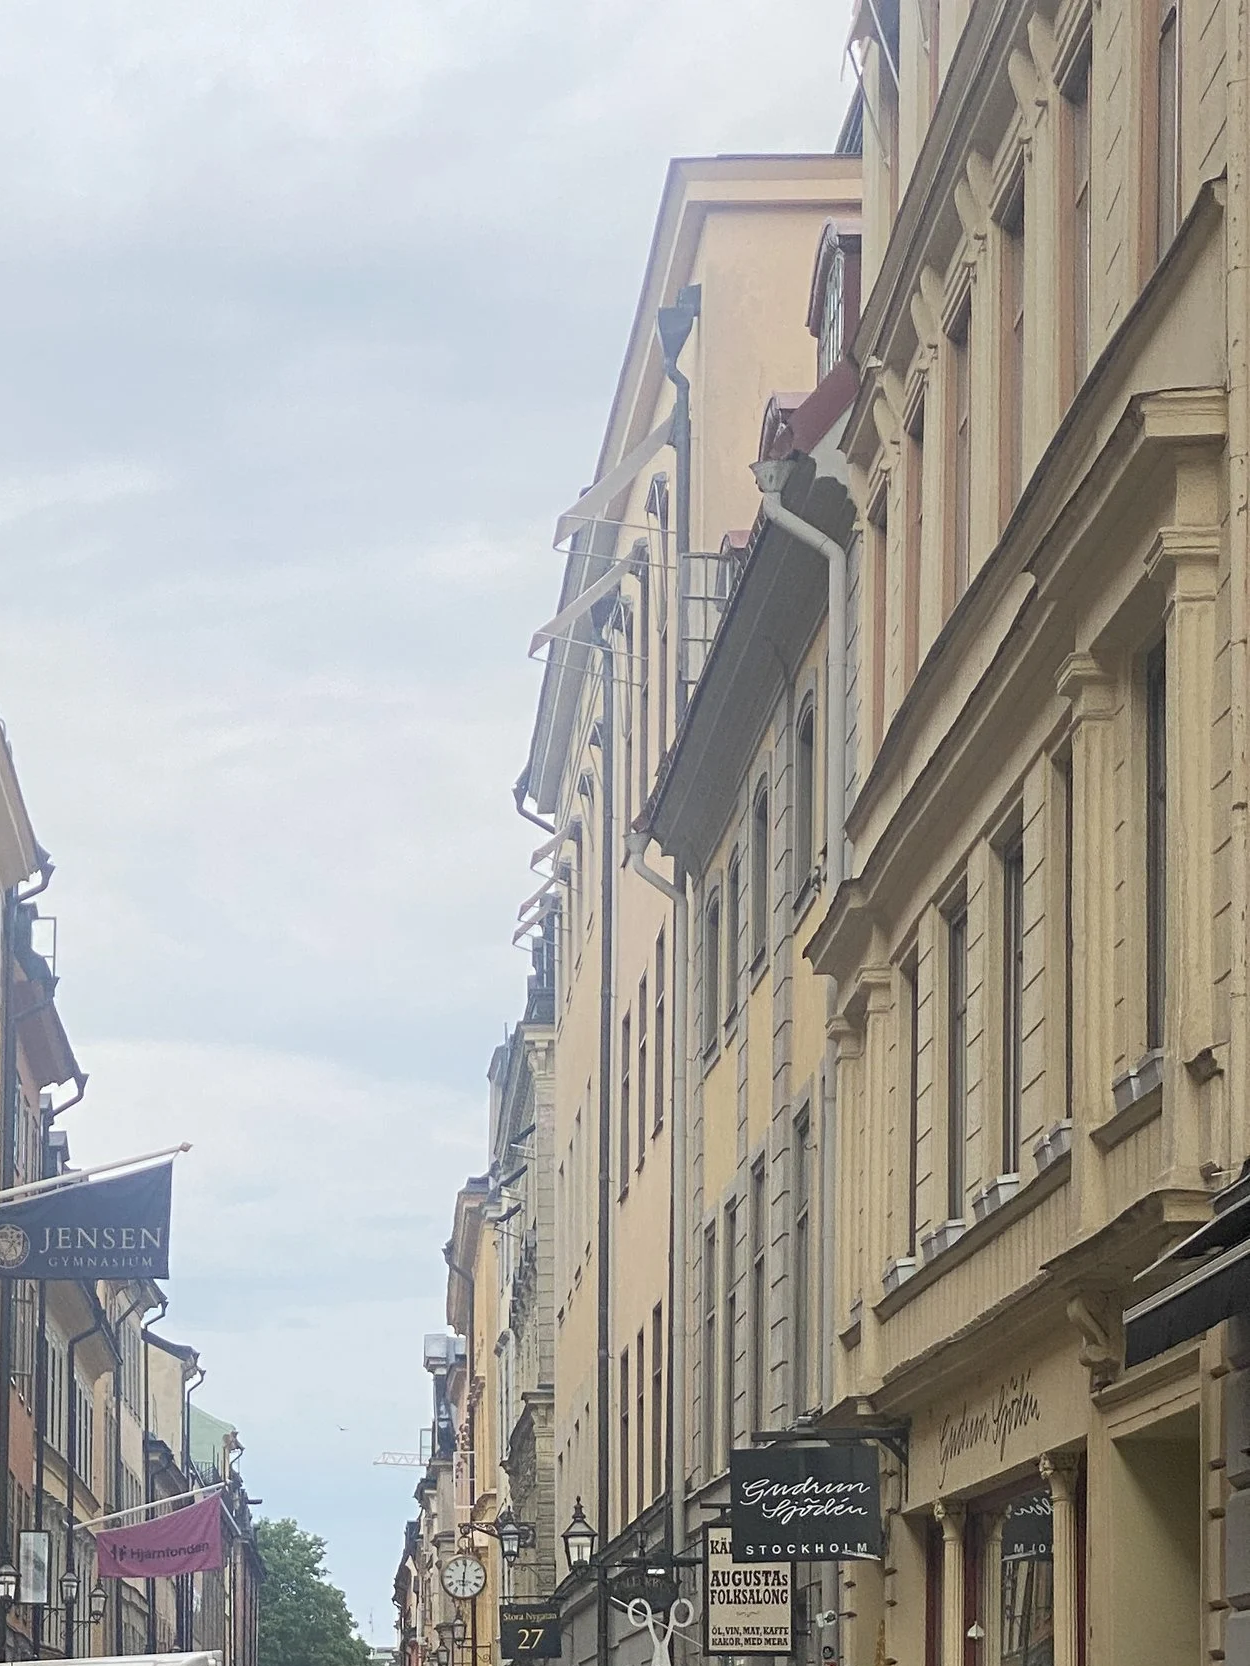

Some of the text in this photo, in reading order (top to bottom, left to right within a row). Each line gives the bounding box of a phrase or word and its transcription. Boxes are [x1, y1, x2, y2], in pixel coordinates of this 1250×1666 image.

[39, 1227, 162, 1254] JENSEN
[47, 1256, 154, 1268] GYMNASIUM
[740, 1476, 871, 1506] Gudrun
[130, 1541, 210, 1563] Hjärnfonden
[745, 1542, 868, 1555] STOCKHOLM
[710, 1589, 788, 1605] FOLKSALONG
[503, 1612, 557, 1623] Stora Nygatan
[763, 1626, 789, 1635] KAFFE
[517, 1628, 545, 1650] 27
[744, 1637, 762, 1646] MED
[764, 1637, 788, 1646] MERA
